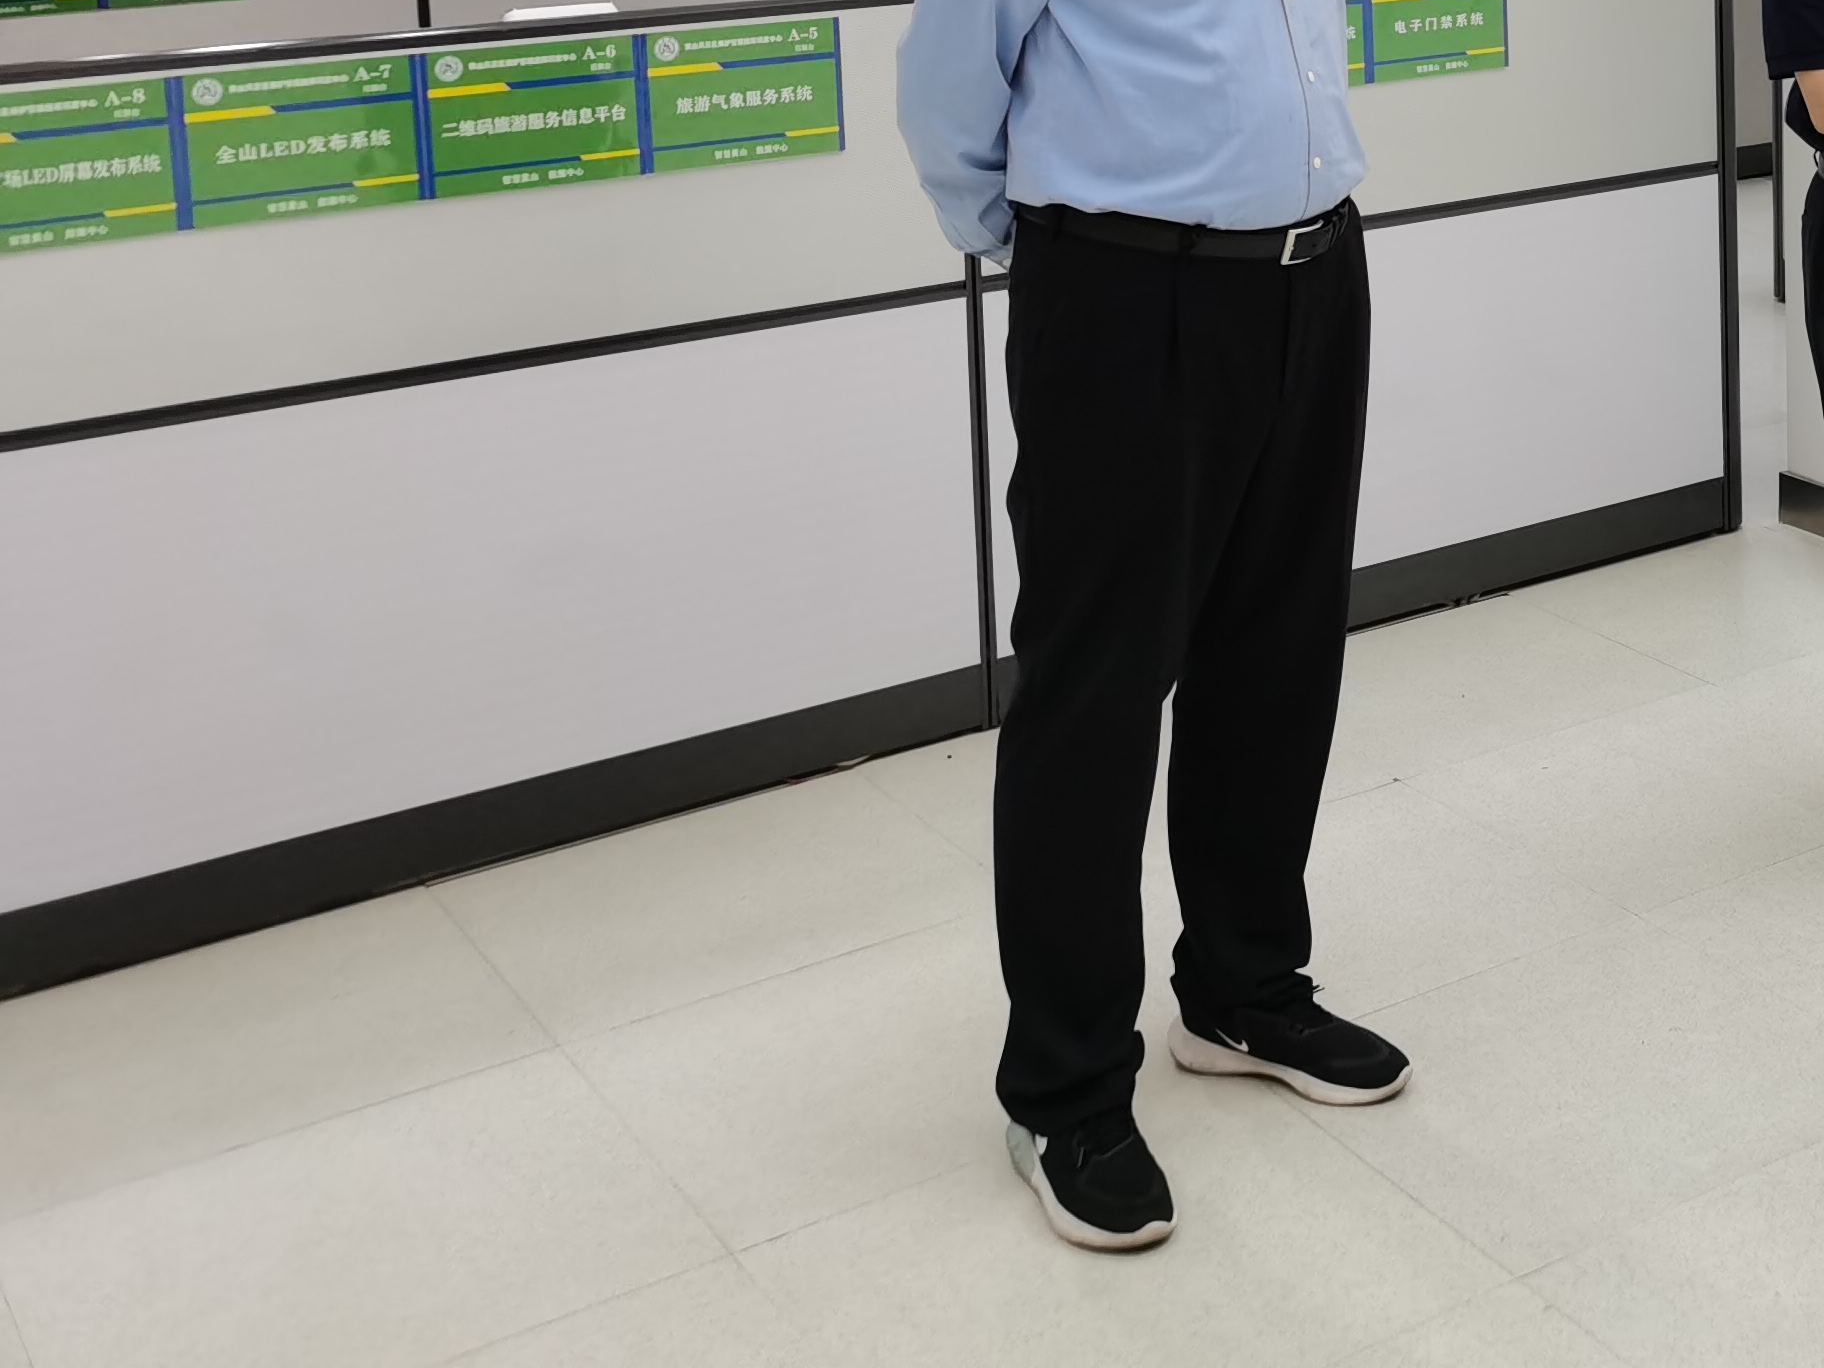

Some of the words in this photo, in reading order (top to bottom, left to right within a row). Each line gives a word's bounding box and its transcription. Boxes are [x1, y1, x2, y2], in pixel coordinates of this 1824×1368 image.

[1394, 12, 1484, 34] 电子门禁系统
[788, 27, 818, 42] A-5
[582, 44, 616, 61] A-6
[353, 64, 392, 82] A-7
[105, 88, 145, 107] A-8
[676, 85, 813, 114] 旅游气象服务系统
[441, 104, 626, 138] 二维码旅游服务信息平台
[216, 129, 391, 165] 全山LED发布系统
[0, 154, 162, 188] 场LED屏幕发布系统
